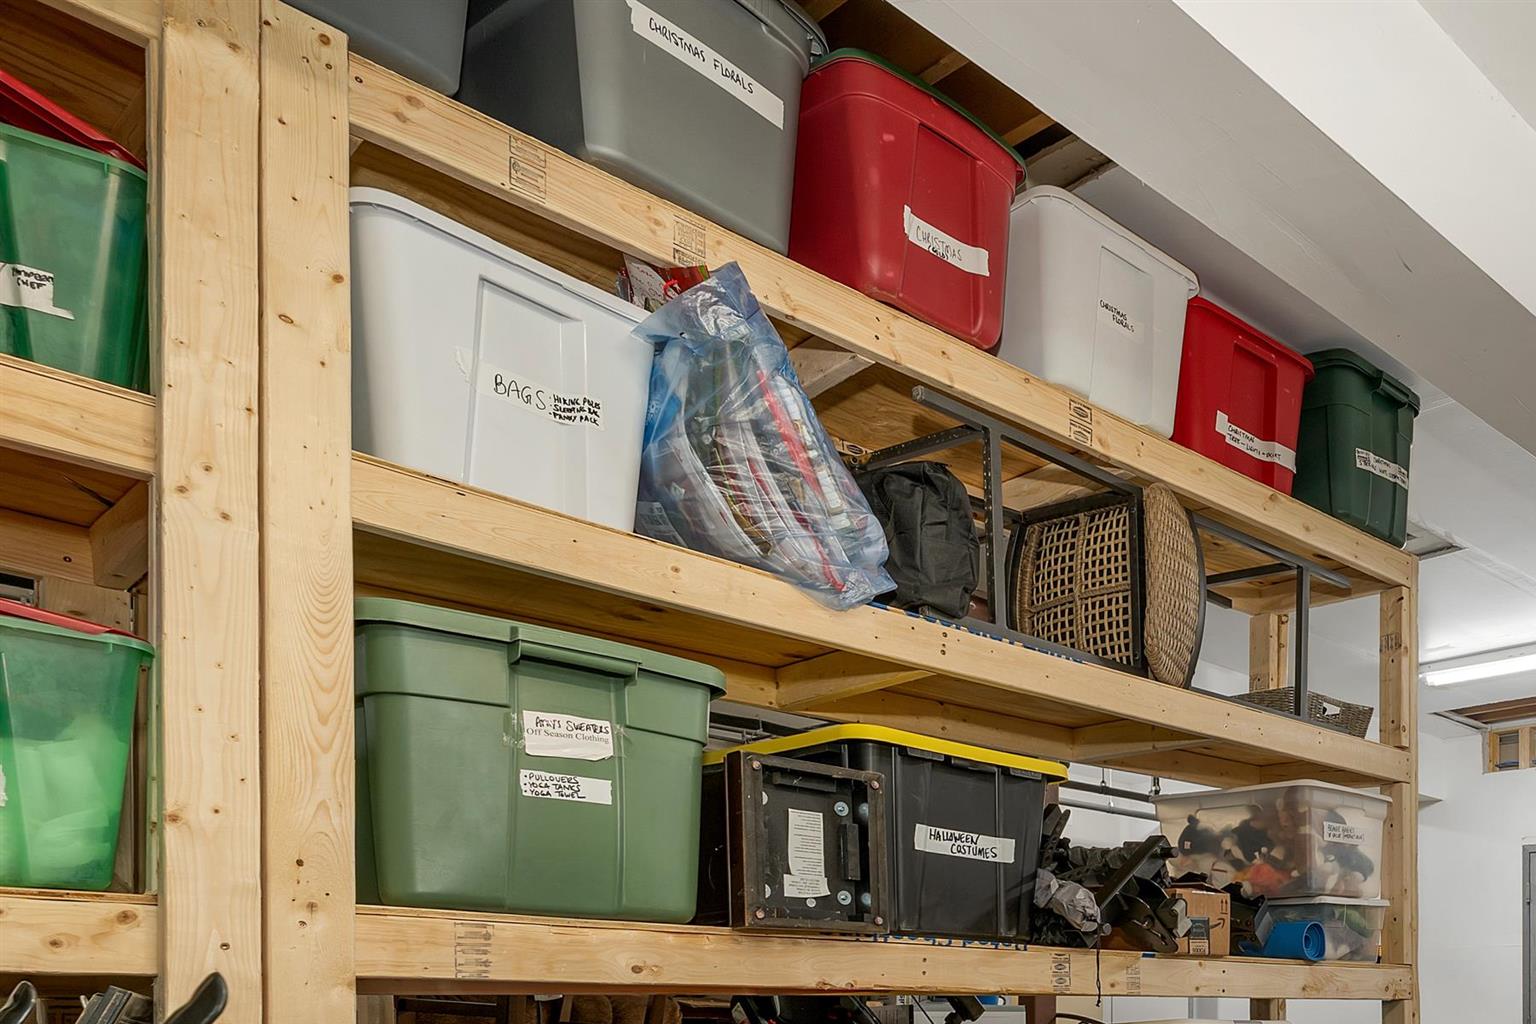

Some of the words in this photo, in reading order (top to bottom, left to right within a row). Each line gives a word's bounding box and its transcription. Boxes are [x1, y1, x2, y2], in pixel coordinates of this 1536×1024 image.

[649, 17, 706, 63] CHRISTMAS
[713, 58, 754, 95] FLORALS
[916, 225, 962, 262] CHRISTMAS
[494, 373, 546, 411] BAGS
[526, 727, 542, 736] Off
[543, 729, 574, 740] Season
[575, 733, 609, 745] Clothing
[566, 720, 610, 735] SWEATERS
[528, 772, 580, 785] PULLOVERS
[528, 781, 551, 790] YOGA
[529, 788, 552, 797] YOGA
[555, 790, 587, 799] TOWEL
[928, 828, 981, 846] HALLOWEEN
[950, 843, 998, 859] COSTUMES
